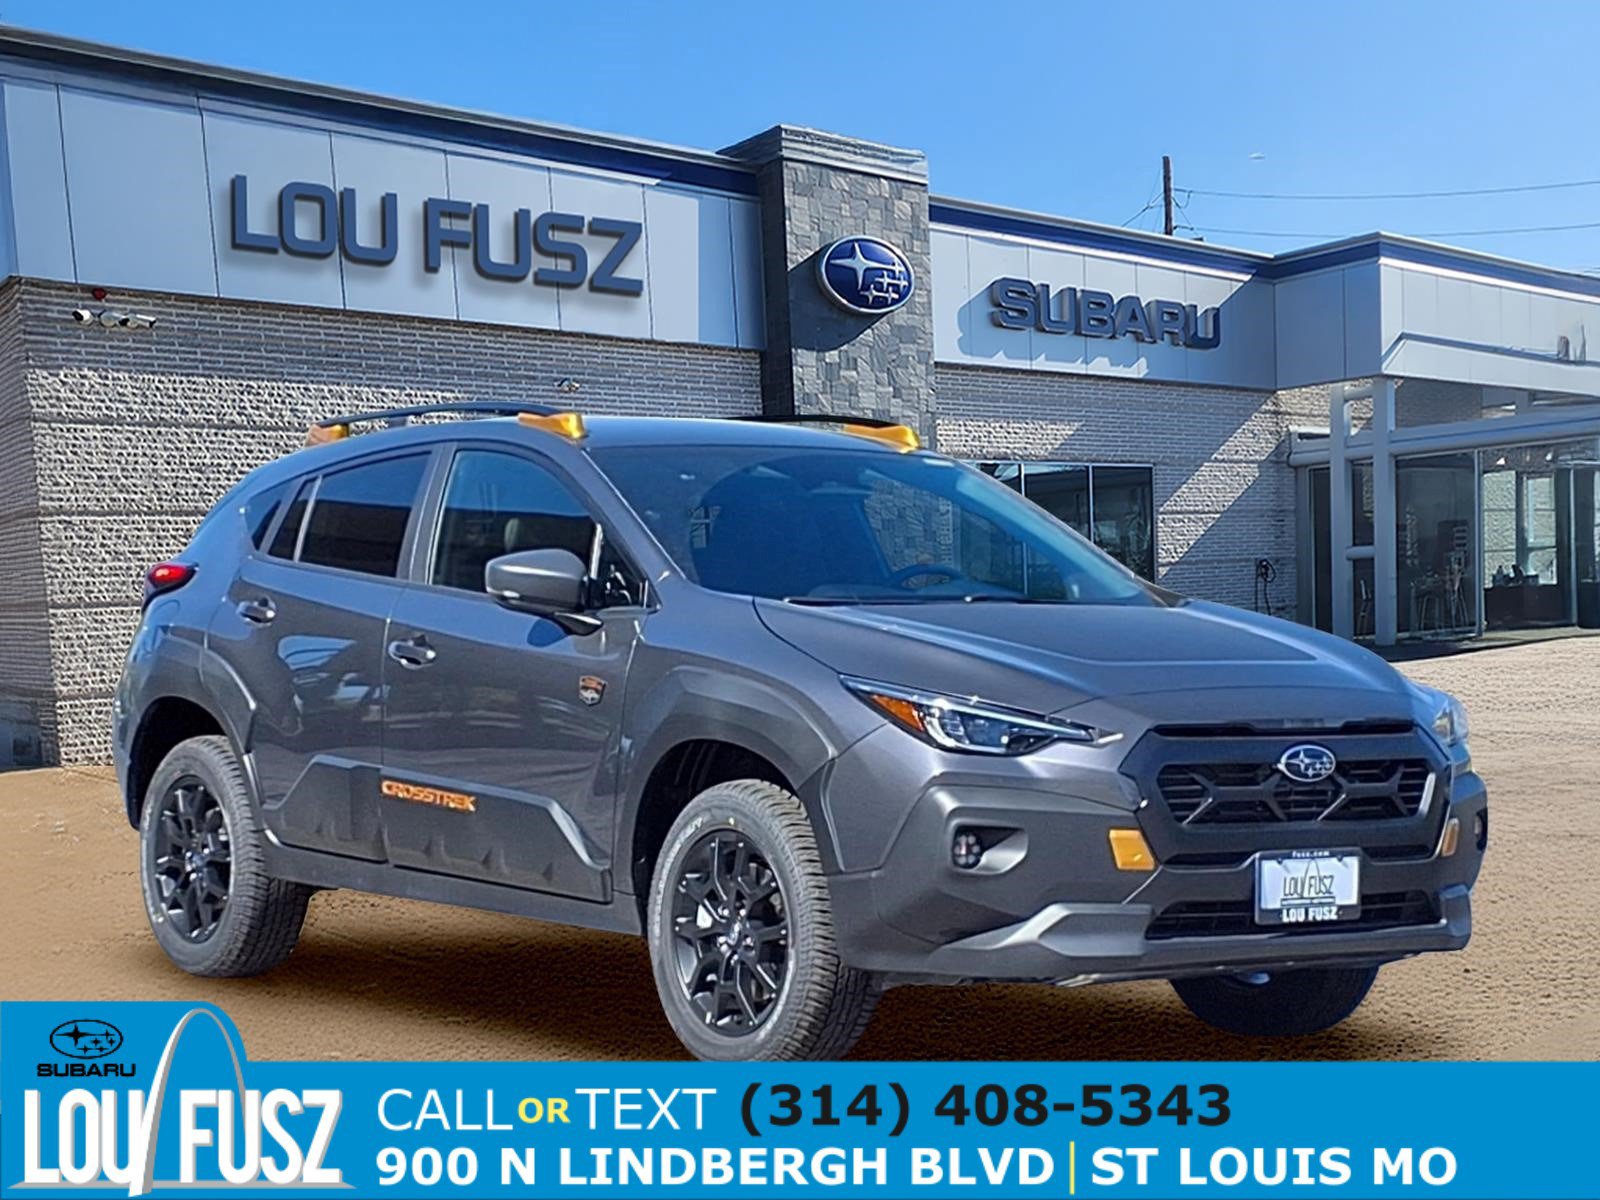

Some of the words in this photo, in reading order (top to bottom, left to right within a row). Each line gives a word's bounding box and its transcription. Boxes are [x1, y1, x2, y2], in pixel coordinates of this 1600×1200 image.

[231, 174, 399, 268] LOU
[424, 197, 644, 297] FUSZ
[990, 276, 1222, 350] SUBARU
[1283, 876, 1305, 897] LOU
[1308, 875, 1335, 896] FUSZ
[1282, 908, 1305, 922] LOU
[1308, 905, 1338, 921] FUSZ
